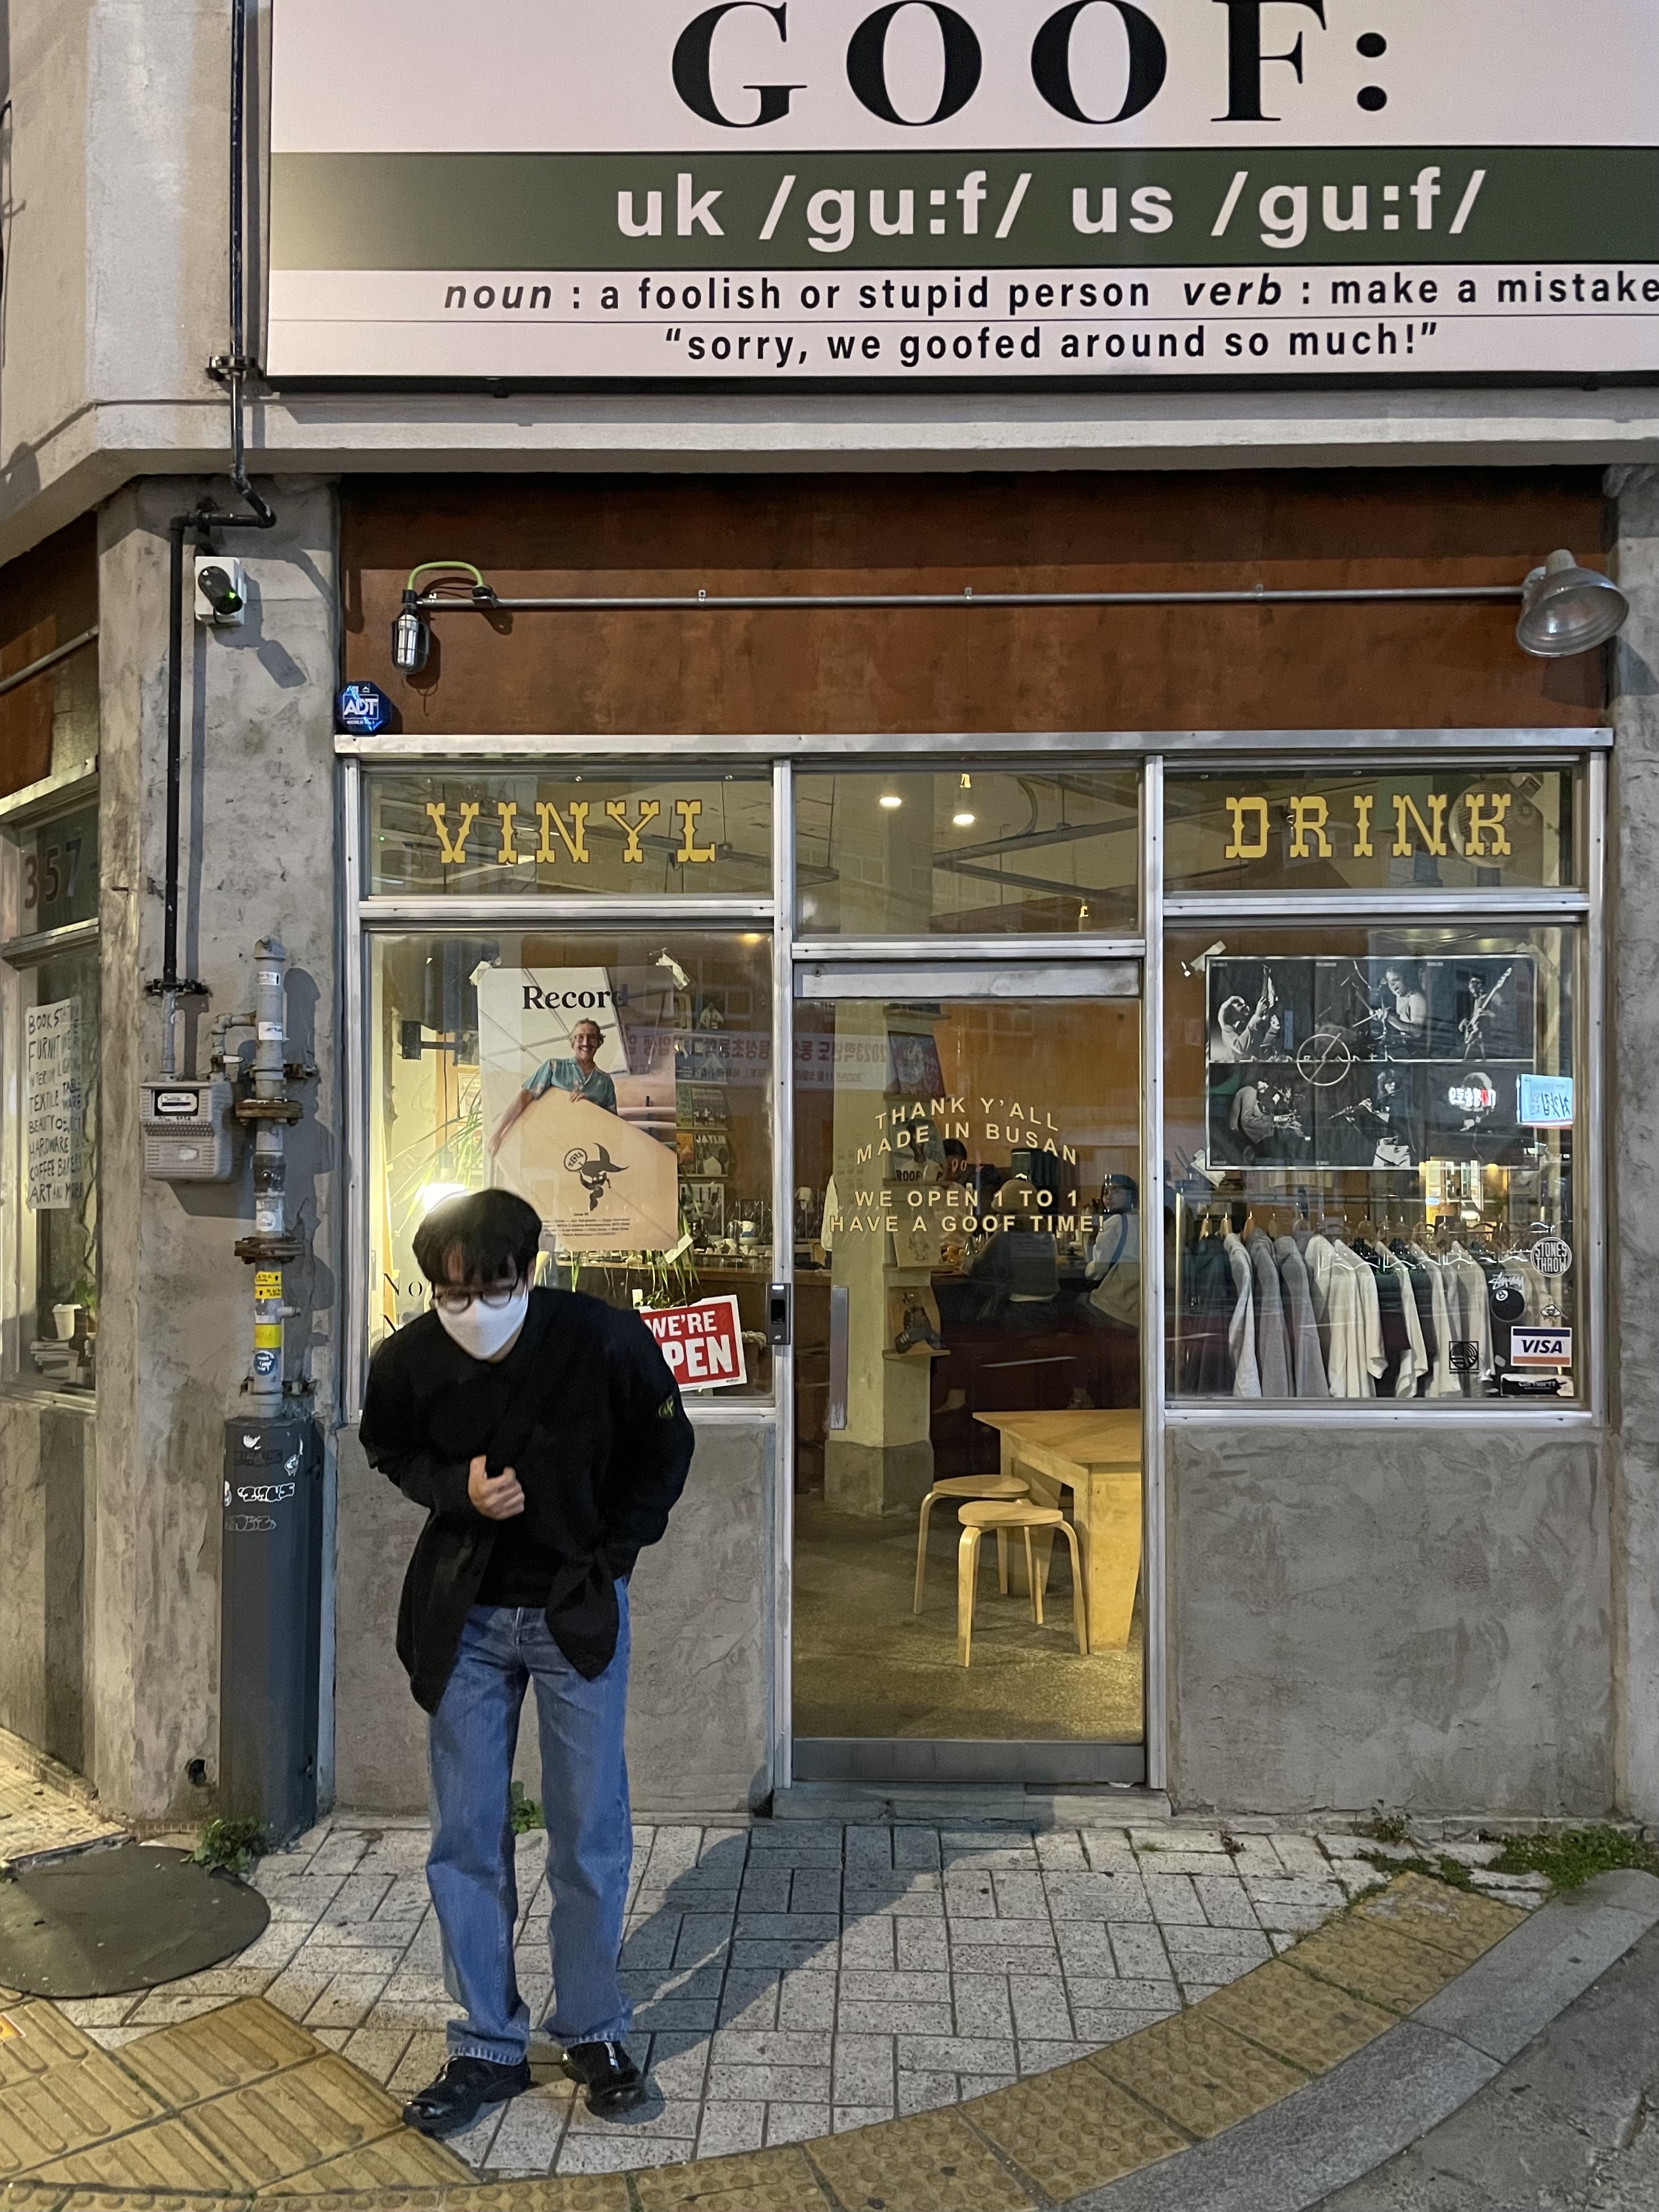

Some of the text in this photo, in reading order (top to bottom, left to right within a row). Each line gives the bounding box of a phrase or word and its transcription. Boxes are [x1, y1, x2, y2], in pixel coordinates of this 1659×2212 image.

[672, 0, 1387, 128] GOOF:
[618, 167, 1486, 252] uk /gu:f/ us /gu:f/
[445, 270, 1659, 316] noun : a foolish or stupid person verb : make a mistake
[827, 336, 880, 359] we
[900, 325, 1041, 367] goofed
[1060, 326, 1206, 358] around
[1224, 332, 1269, 356] so
[344, 698, 378, 715] ADT
[425, 799, 716, 864] VINYL
[1224, 792, 1513, 859] DRINK
[522, 983, 630, 1009] Record
[874, 1097, 966, 1131] THANK
[856, 1122, 1077, 1166] MADE IN BUSAN
[30, 1158, 54, 1181] COFFEE
[854, 1190, 1078, 1208] WE OPEN 1 TO 1
[829, 1215, 1104, 1233] HAVE A GOOF TIME!
[1534, 1241, 1569, 1257] STONES
[1535, 1257, 1568, 1273] THROW
[661, 1334, 733, 1378] PEN
[1521, 1339, 1563, 1354] VISA
